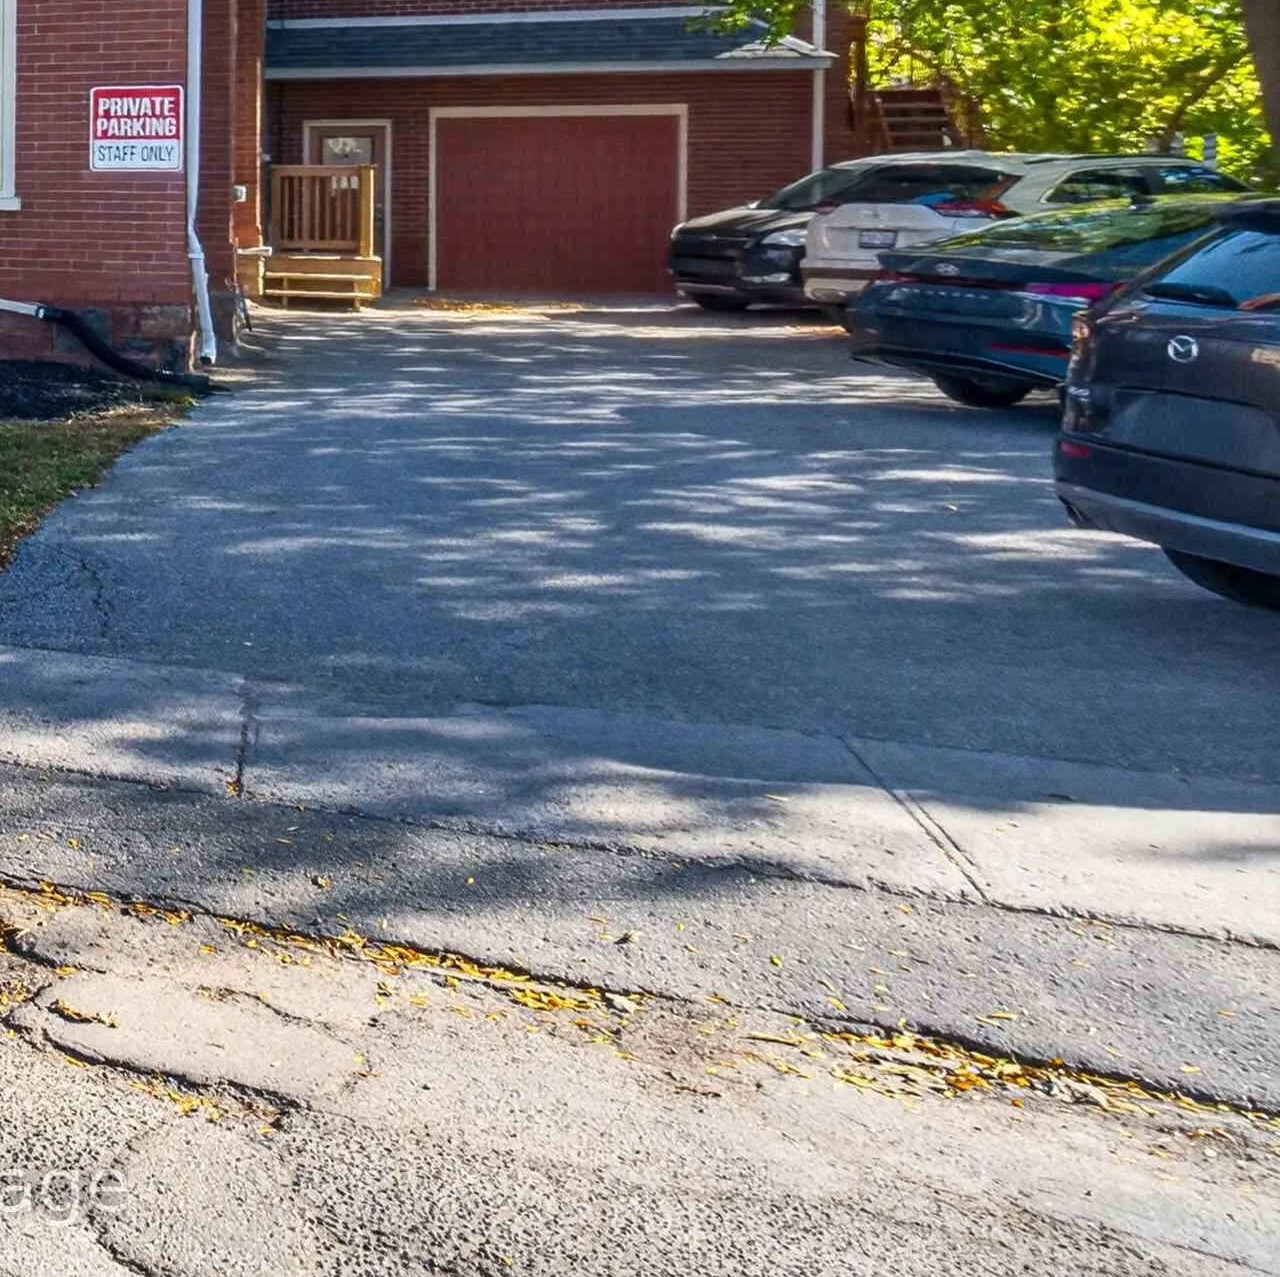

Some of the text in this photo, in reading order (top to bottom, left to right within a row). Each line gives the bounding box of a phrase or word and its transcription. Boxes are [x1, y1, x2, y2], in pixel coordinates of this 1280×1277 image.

[98, 97, 176, 116] PRIVATE
[96, 117, 176, 136] PARKING
[98, 145, 174, 161] STAFF ONLY
